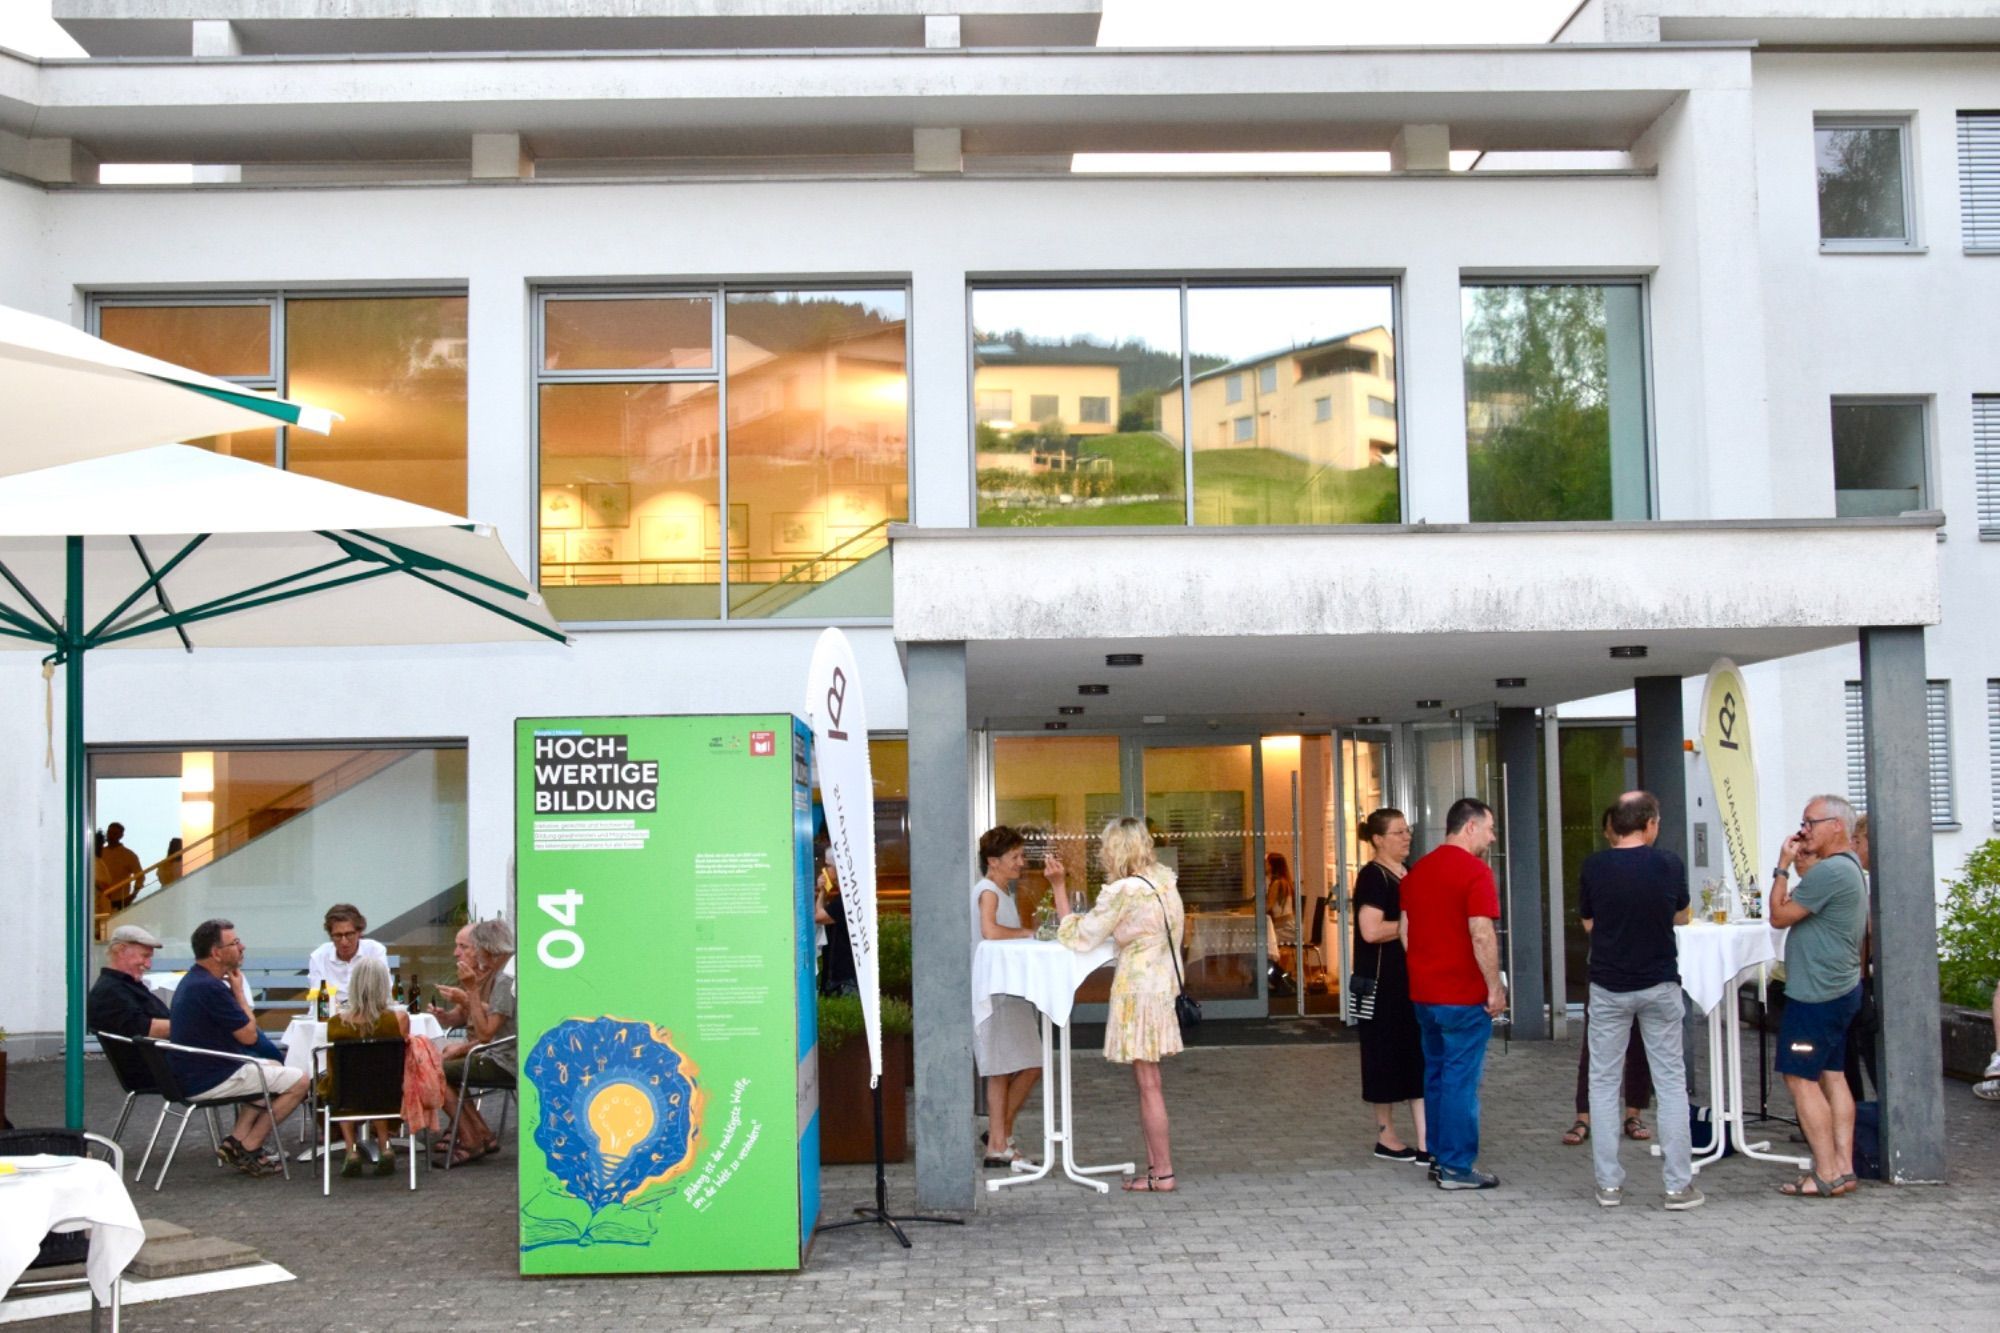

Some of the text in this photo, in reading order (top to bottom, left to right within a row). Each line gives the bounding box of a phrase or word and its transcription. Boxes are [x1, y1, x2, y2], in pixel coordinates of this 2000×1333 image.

[535, 737, 627, 759] HOCH-
[535, 763, 658, 785] WERTIGE
[535, 789, 656, 811] BILDUNG
[537, 889, 585, 969] 04
